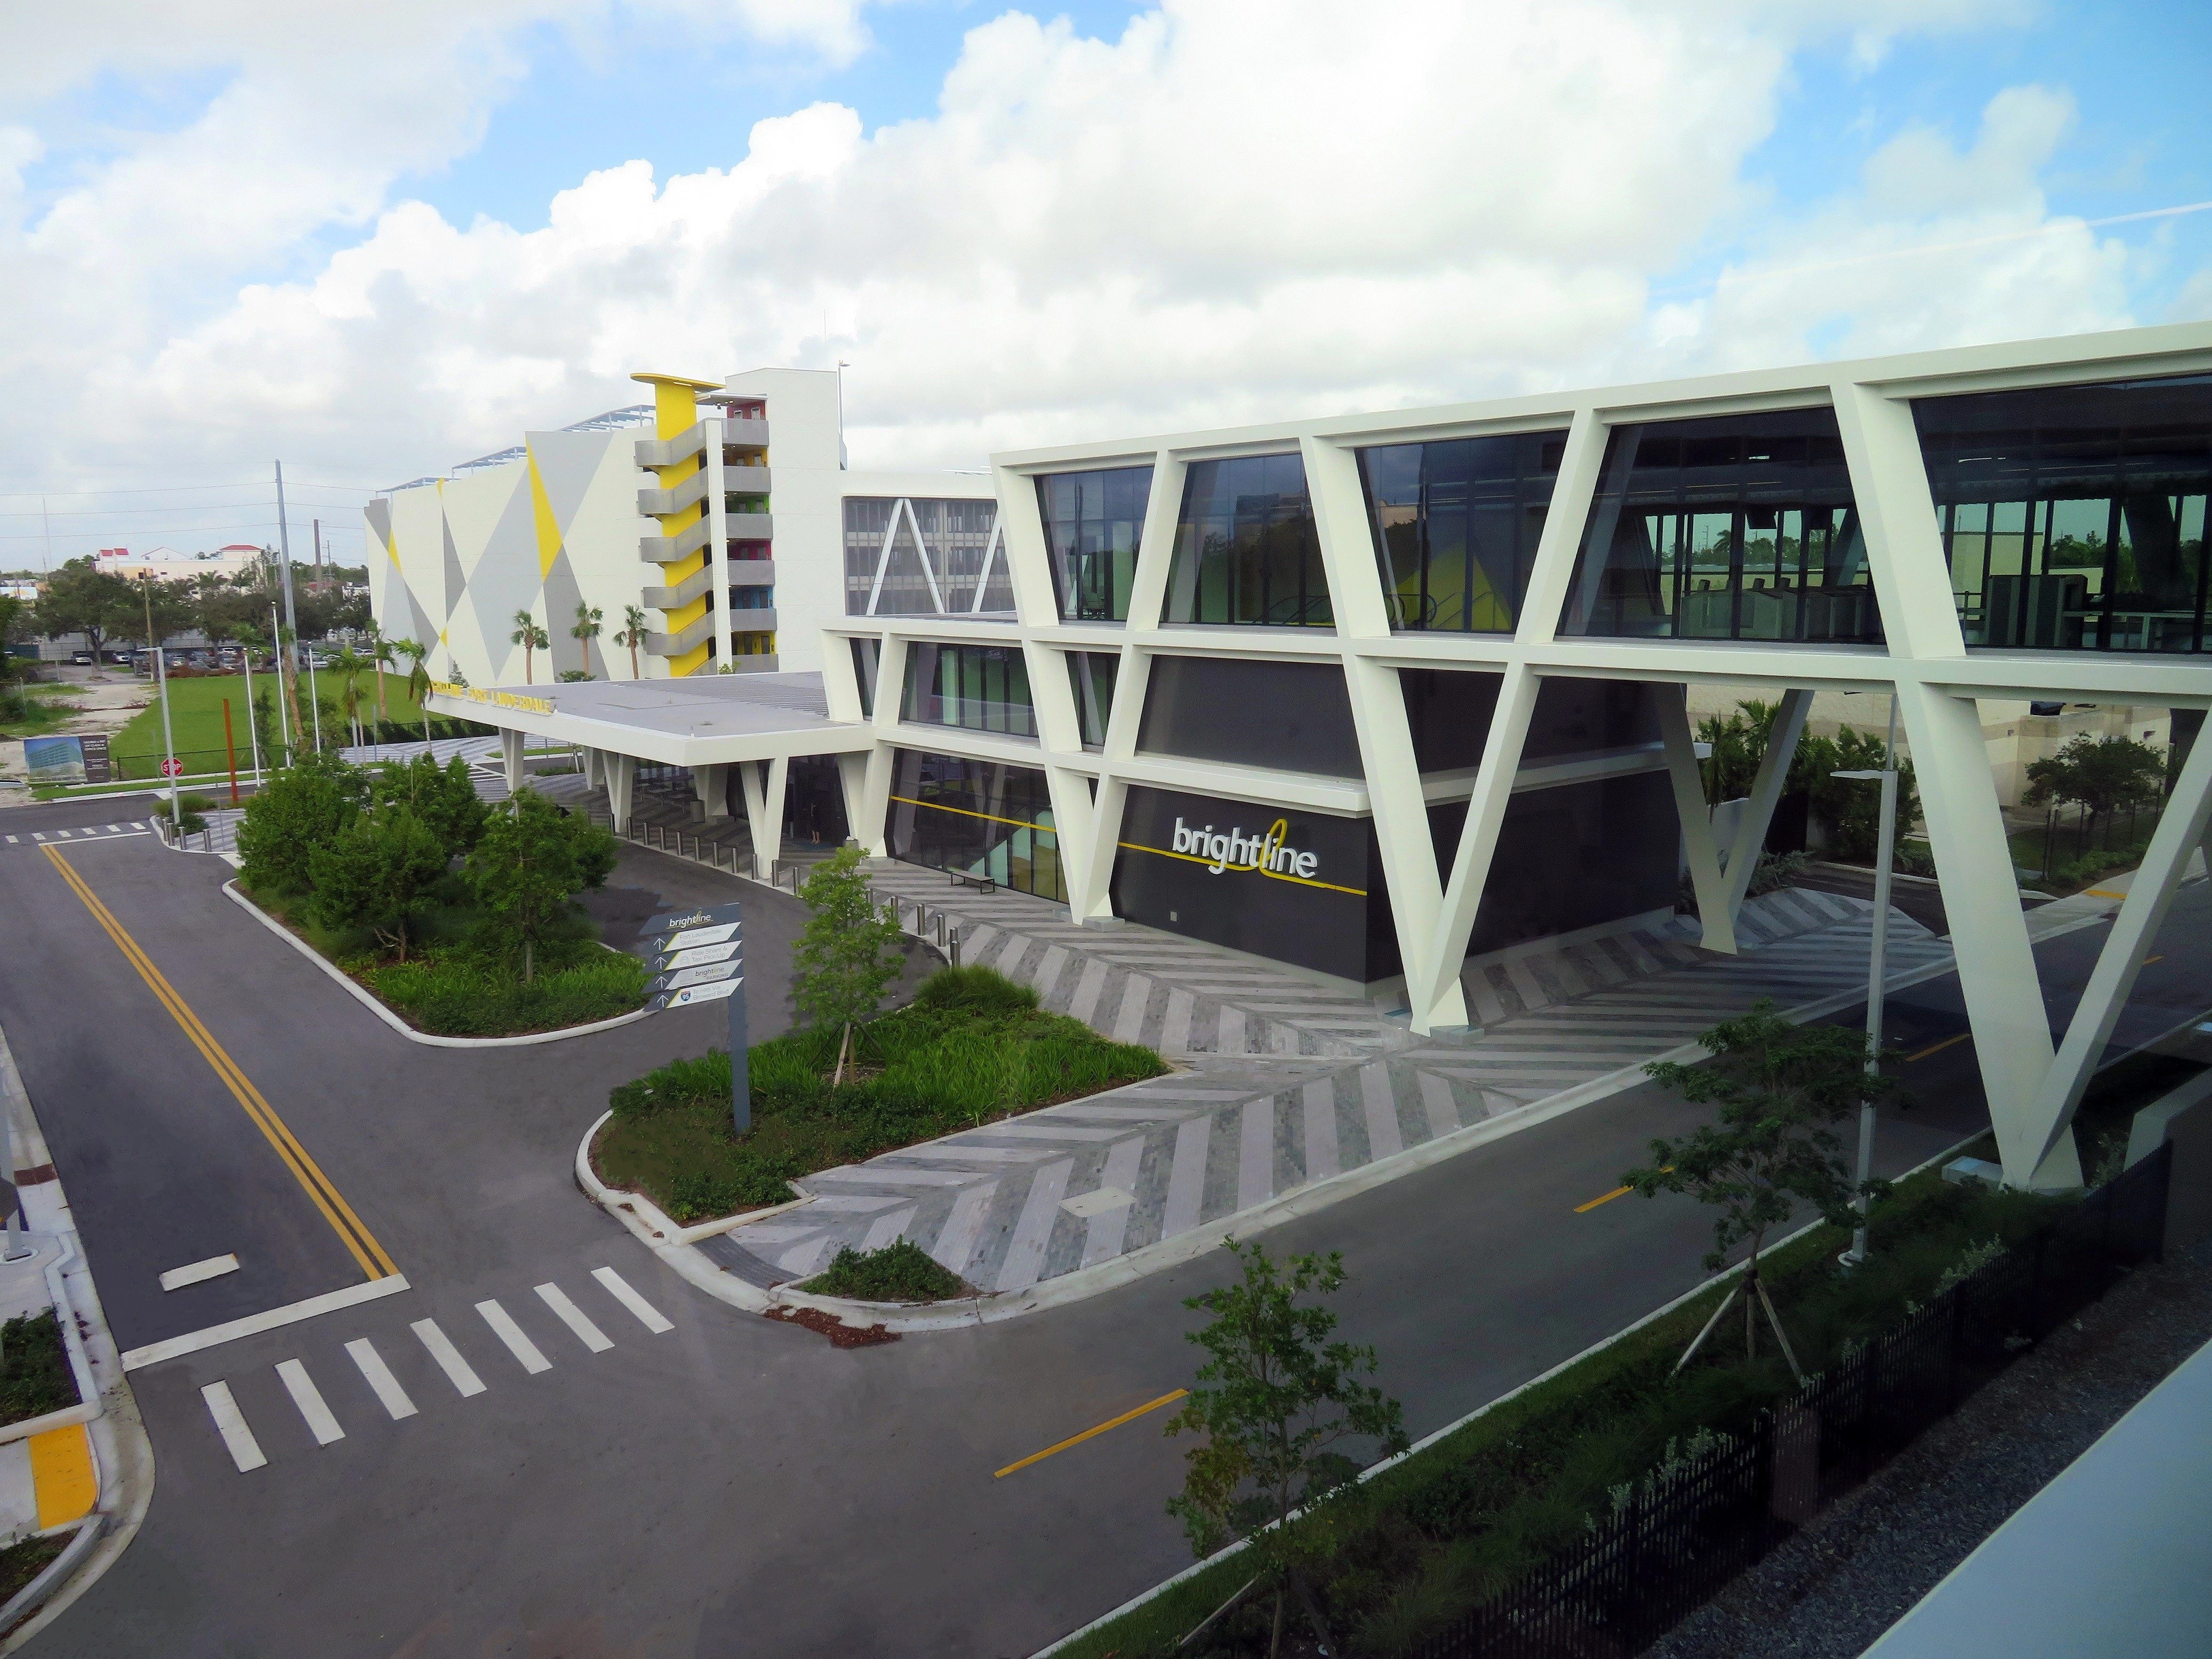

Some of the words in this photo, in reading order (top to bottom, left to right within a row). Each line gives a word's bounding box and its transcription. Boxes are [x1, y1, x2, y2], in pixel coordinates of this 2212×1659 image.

[1172, 817, 1318, 878] brightline
[669, 910, 711, 928] brightline
[692, 929, 722, 938] Lauderdale
[695, 965, 724, 977] brightline
[693, 991, 716, 1000] Broward
